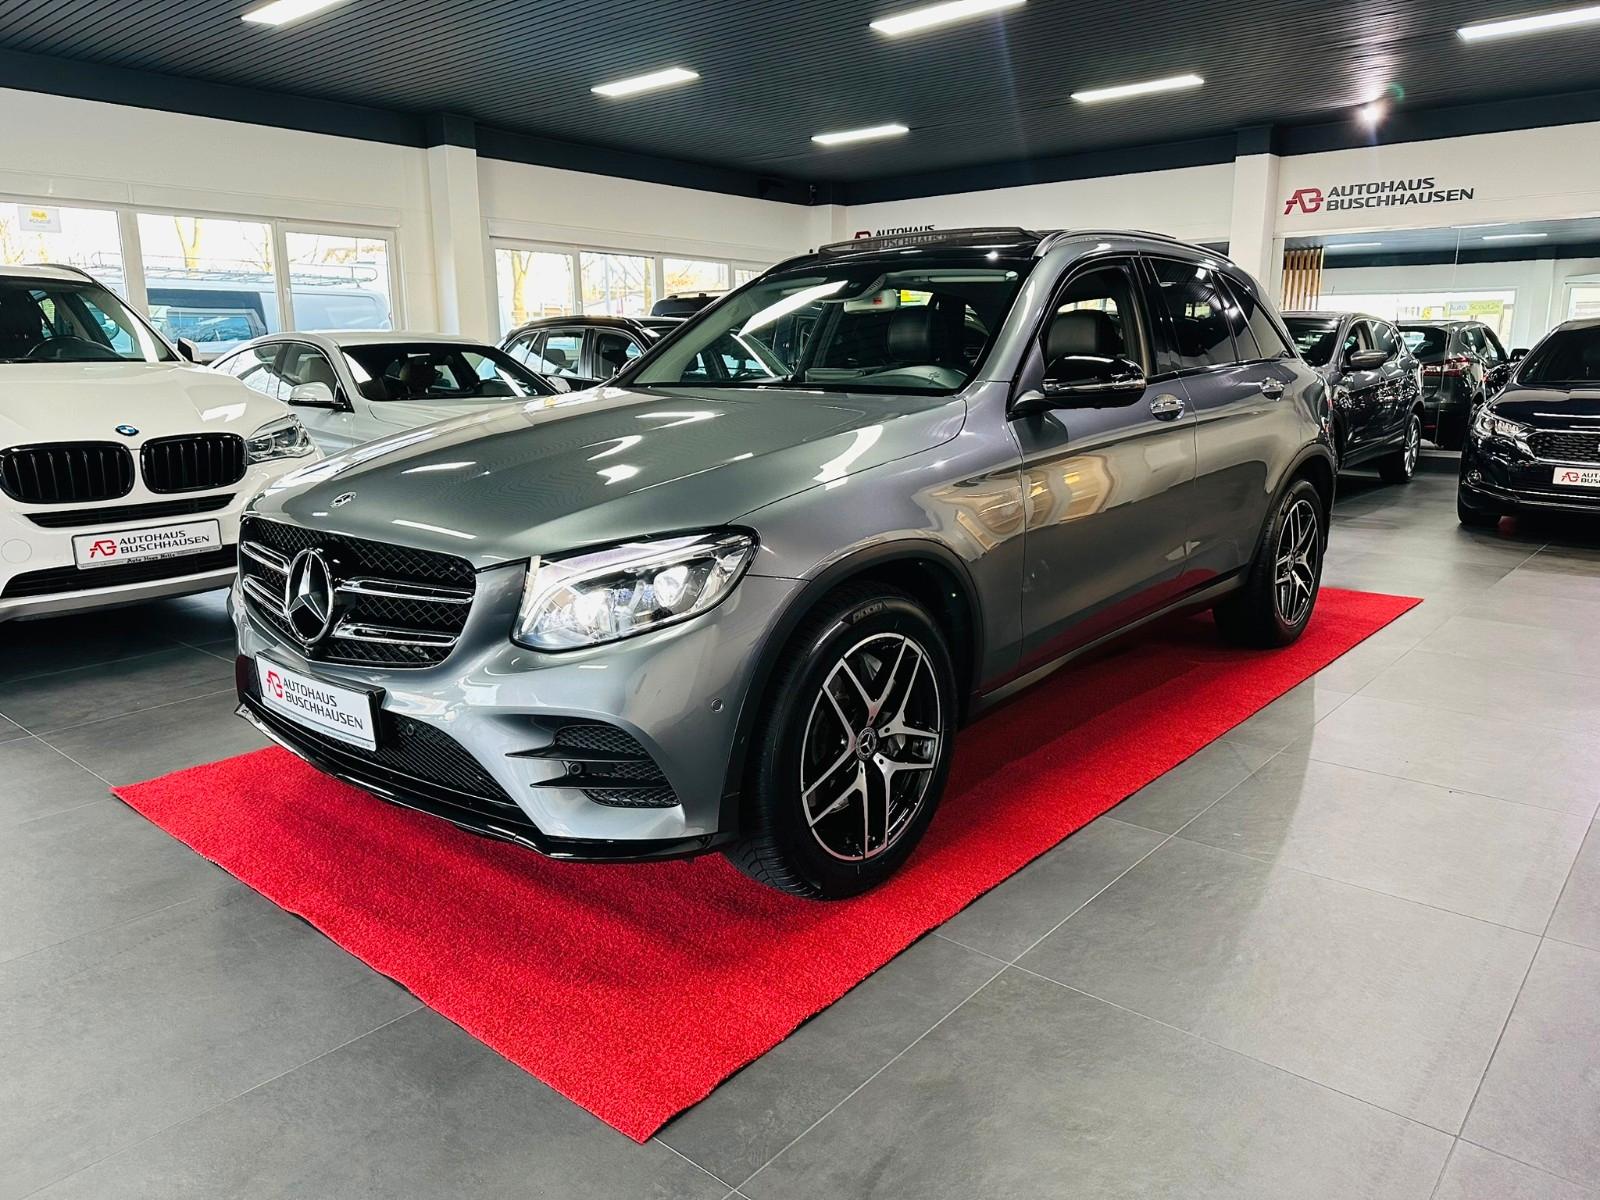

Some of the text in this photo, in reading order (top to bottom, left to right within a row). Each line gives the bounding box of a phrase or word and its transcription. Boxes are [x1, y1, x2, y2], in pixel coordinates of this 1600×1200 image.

[1328, 177, 1435, 198] AUTOHAUS
[1326, 188, 1474, 211] BUSCHHAUSEN
[119, 530, 186, 545] AUTOHAUS
[120, 535, 210, 554] BUSCHHAUSEN
[283, 678, 338, 707] AUTOHAUS
[285, 691, 364, 730] BUSCHHAUSEN
